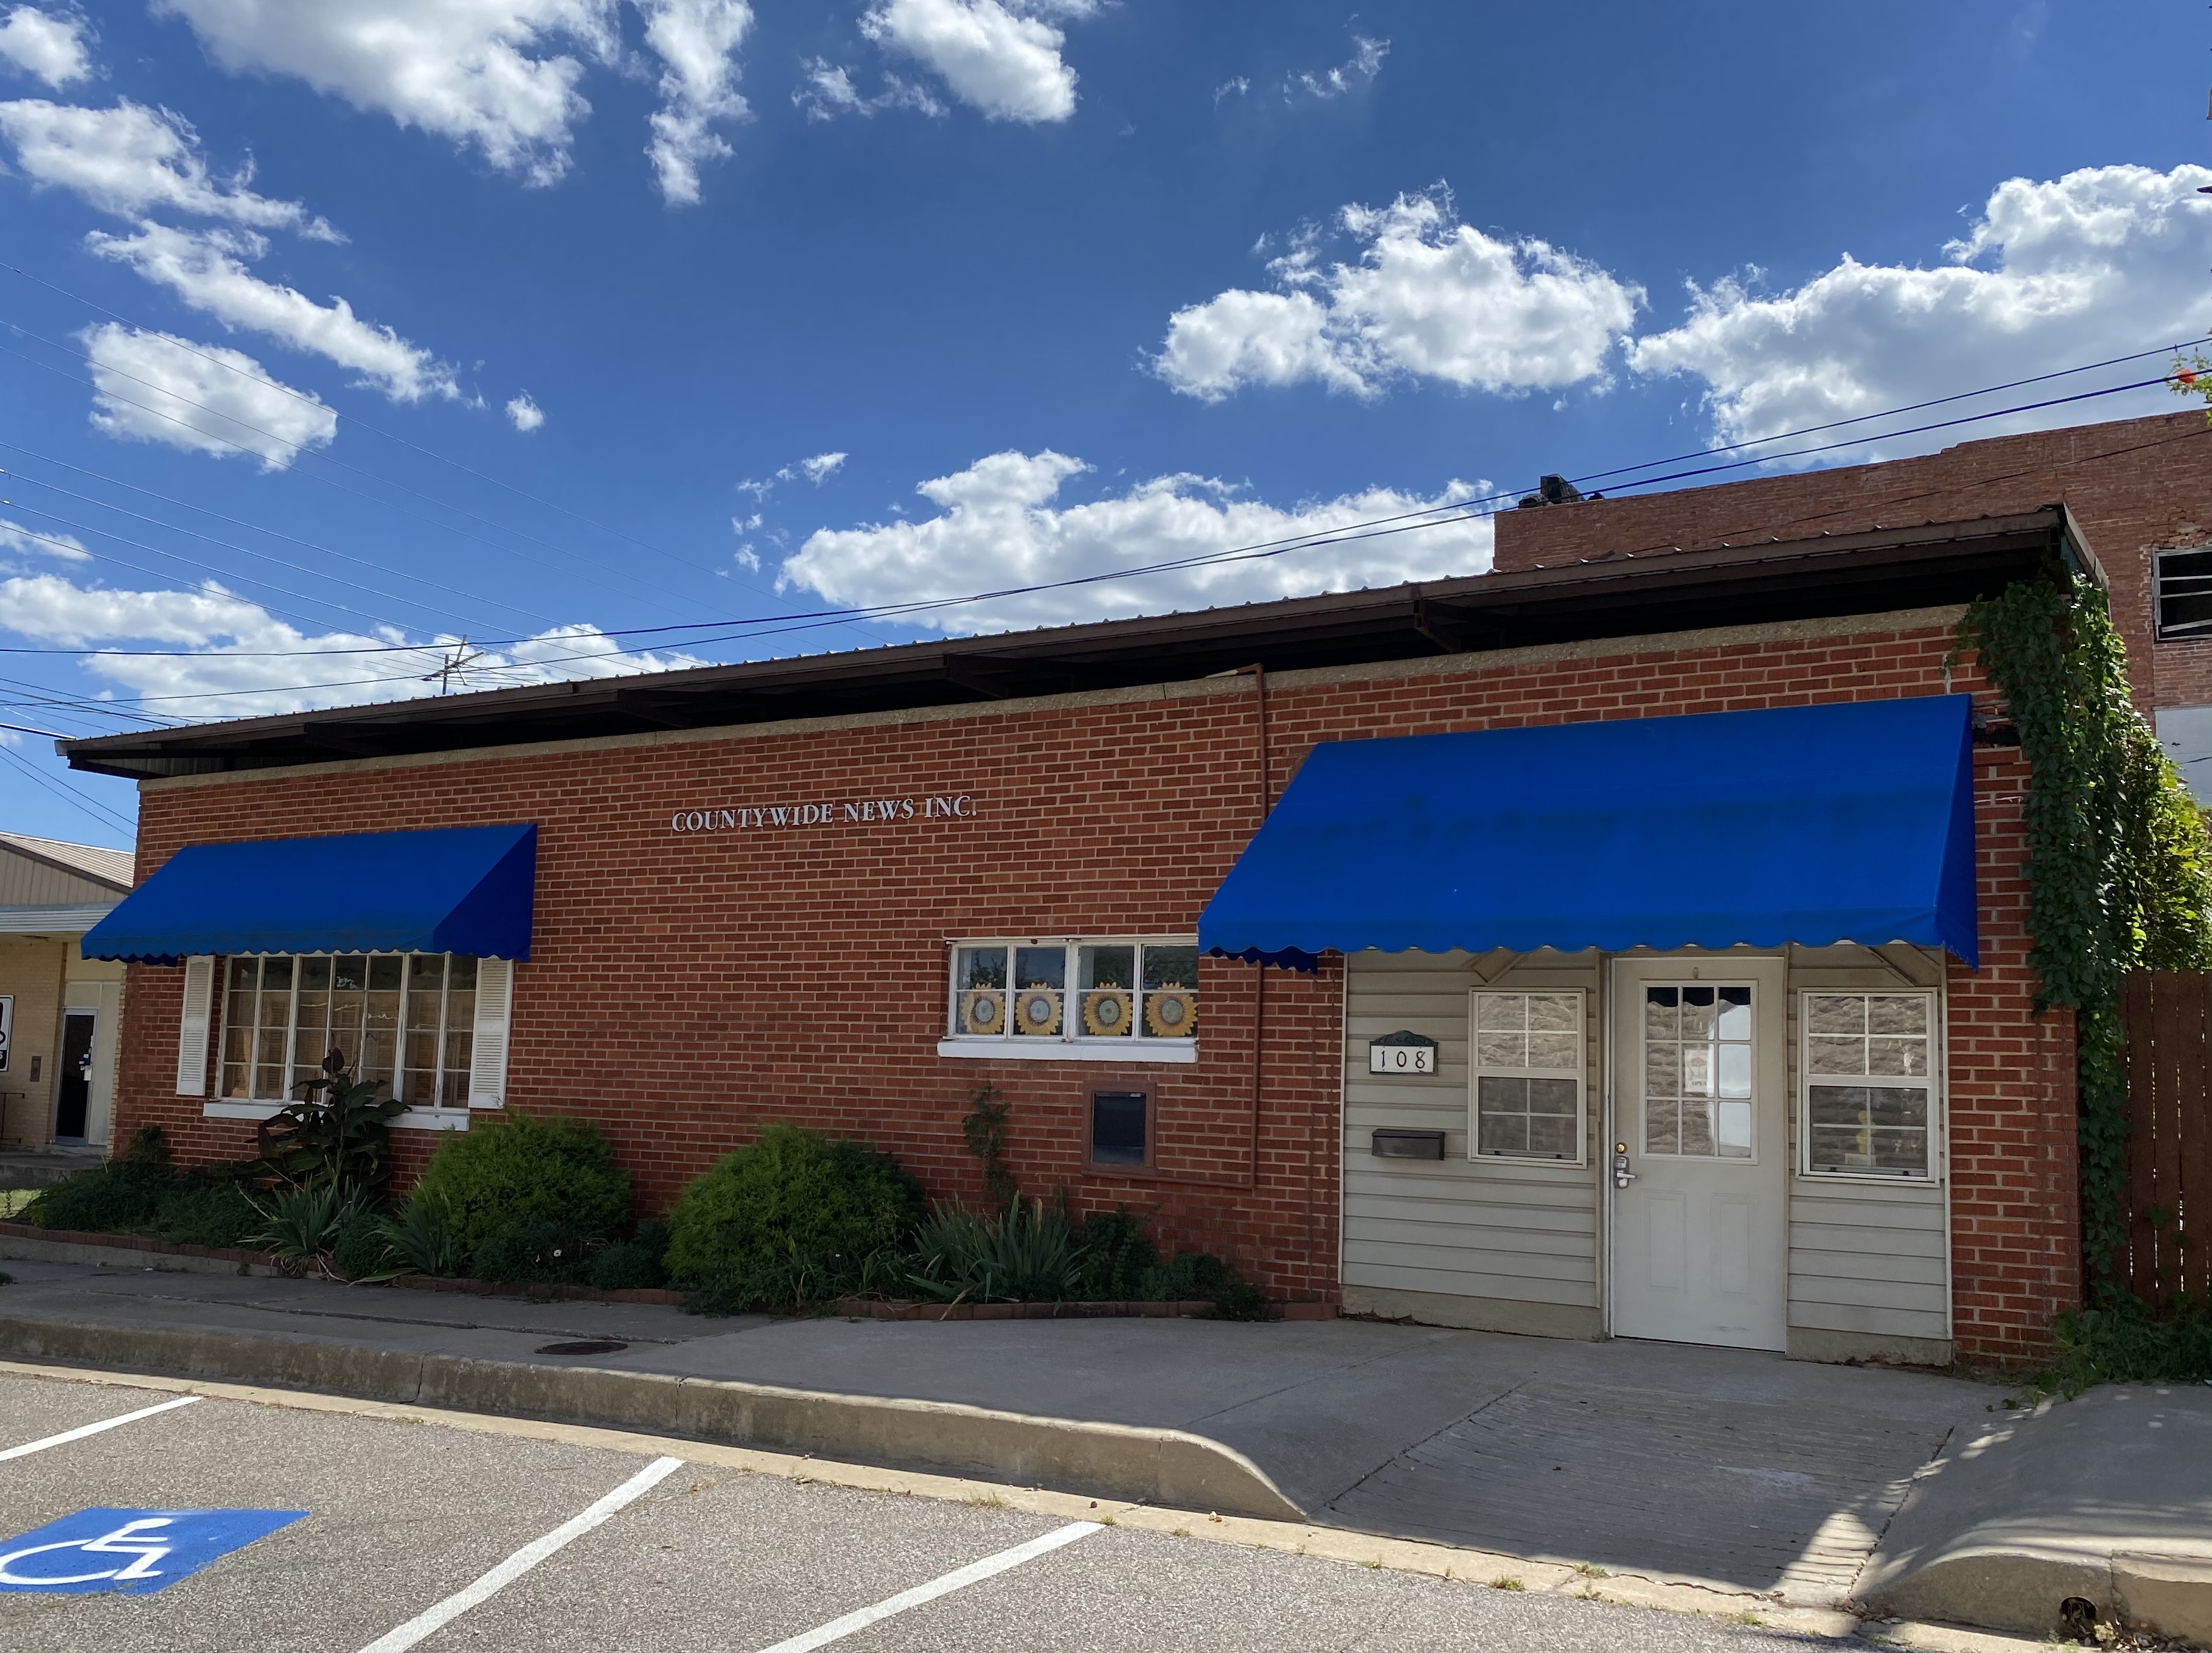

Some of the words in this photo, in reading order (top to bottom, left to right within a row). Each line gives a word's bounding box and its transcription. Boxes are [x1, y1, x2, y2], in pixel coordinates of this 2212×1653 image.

[672, 803, 834, 832] COUNTYWIDE
[843, 798, 914, 823] NEWS
[924, 795, 977, 818] INC.
[1381, 1050, 1426, 1069] 108
